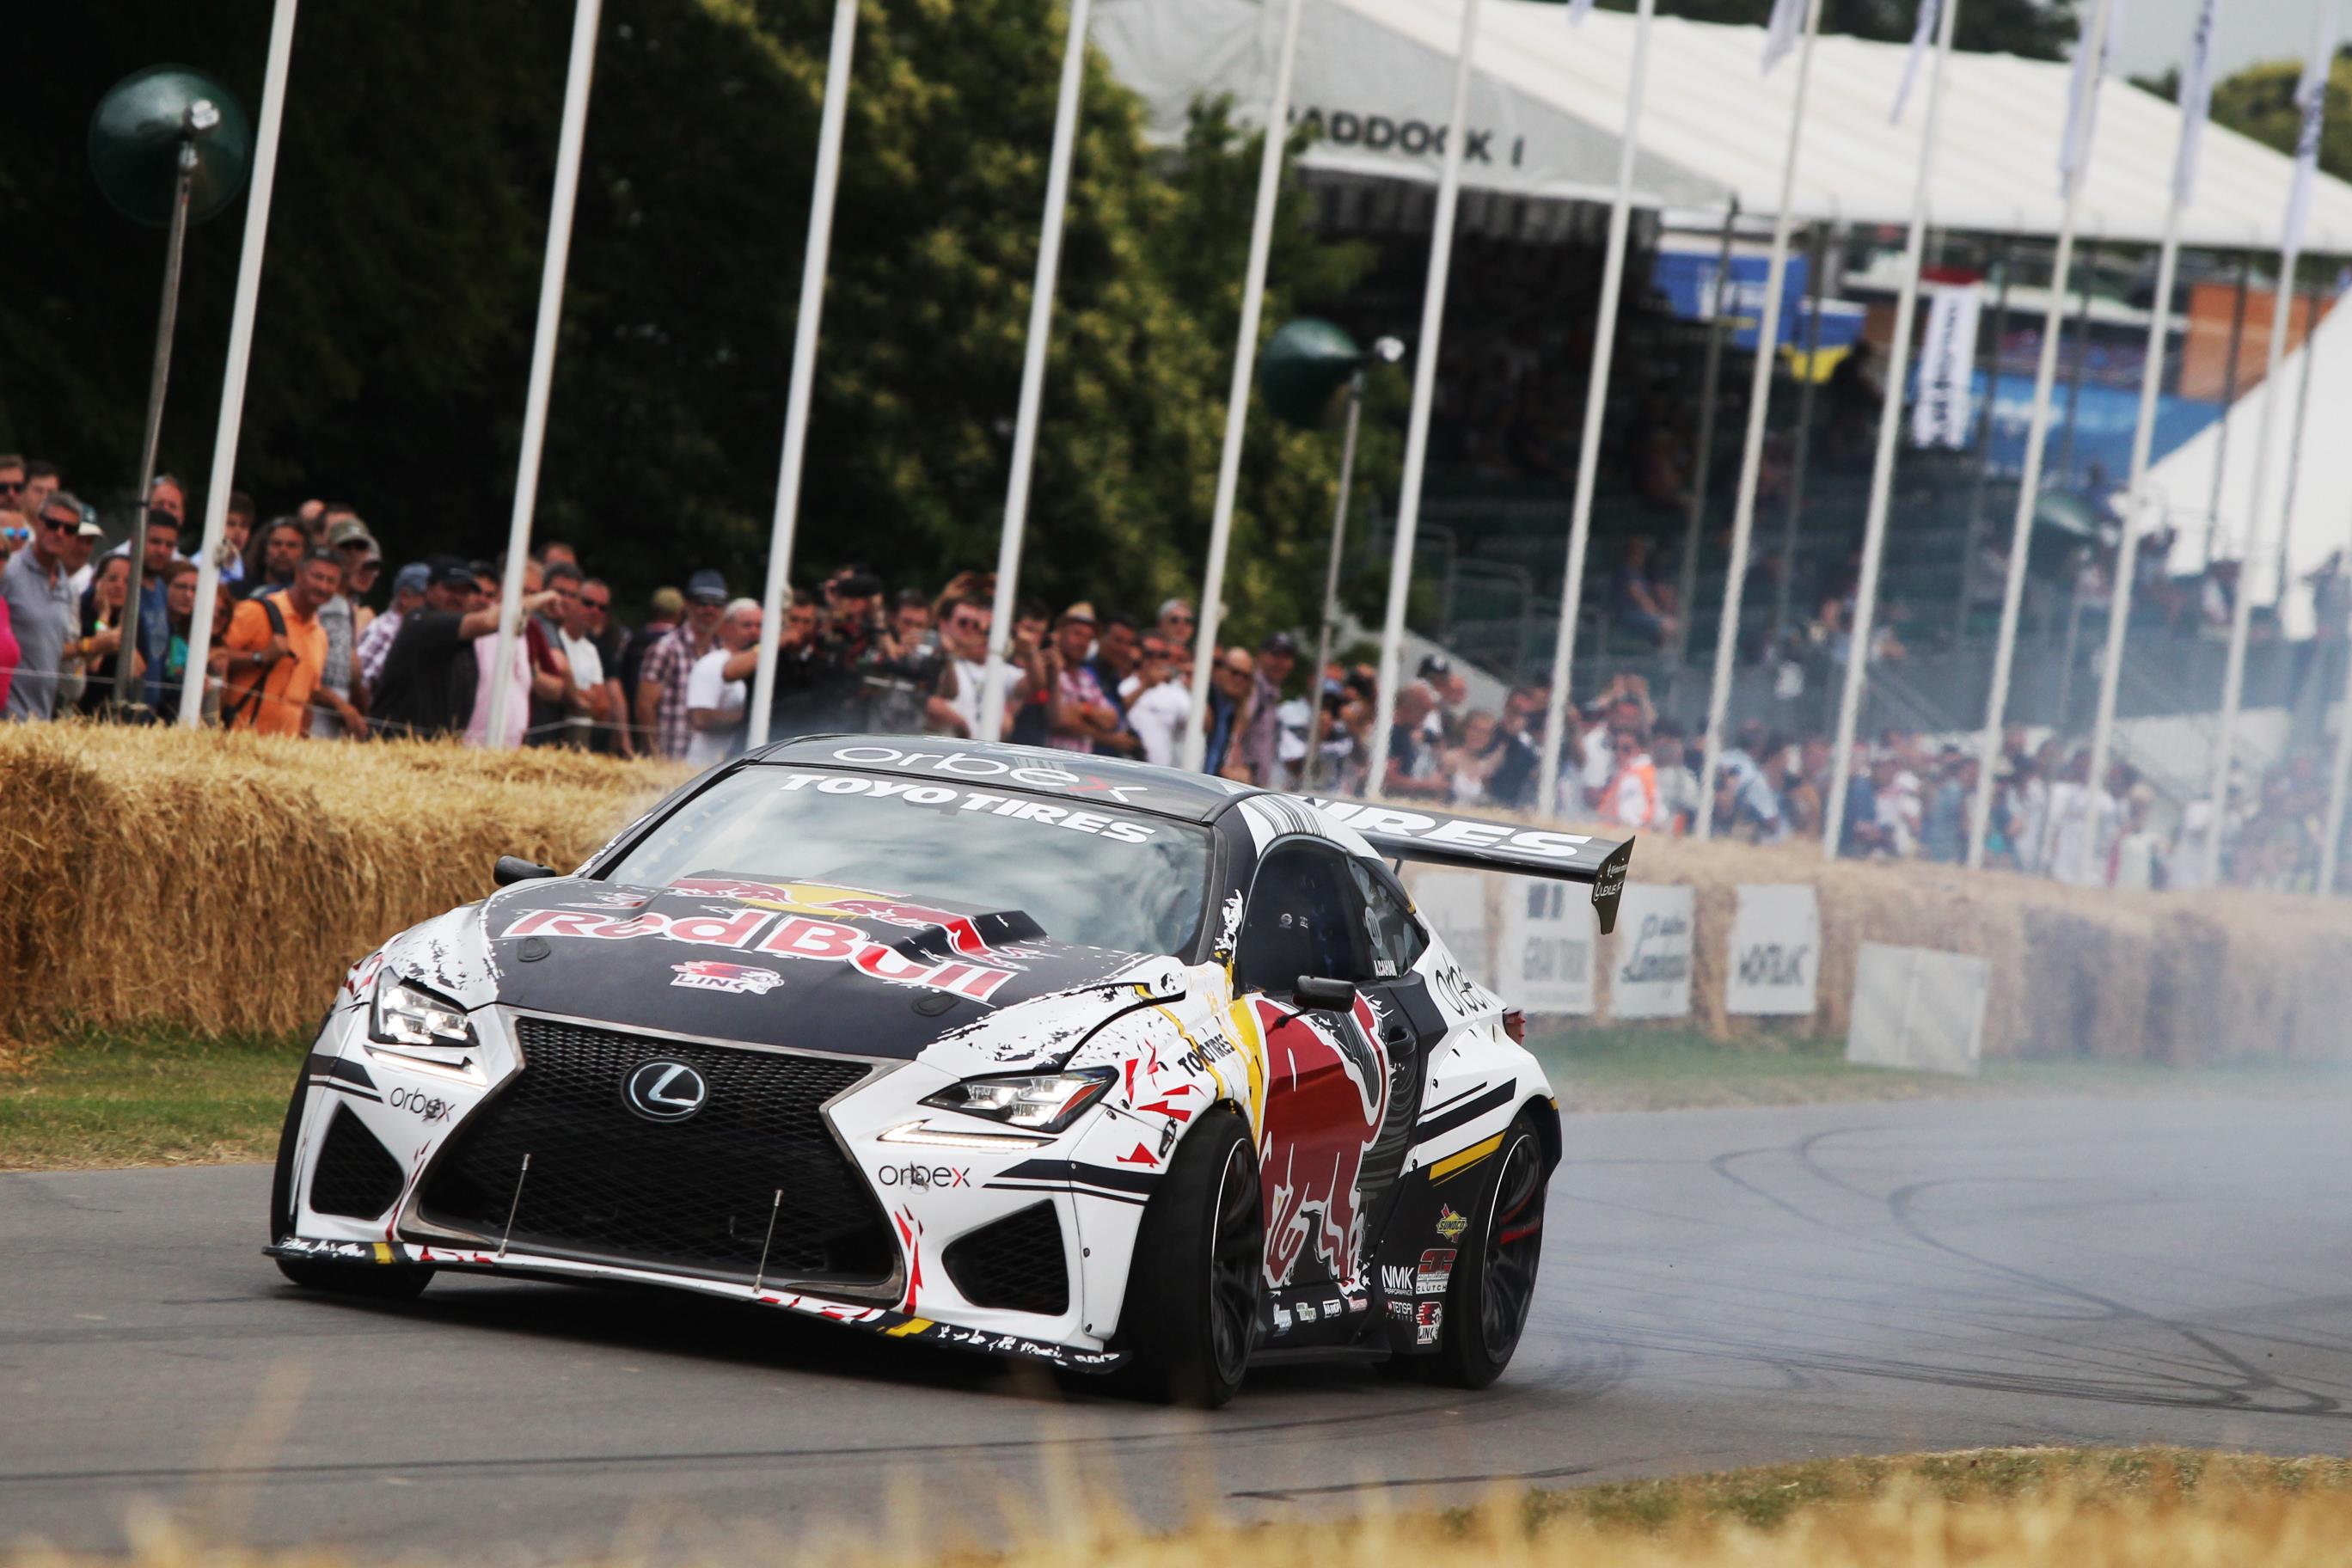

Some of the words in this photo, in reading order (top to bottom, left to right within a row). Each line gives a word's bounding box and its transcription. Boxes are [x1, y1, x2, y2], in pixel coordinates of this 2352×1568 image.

[1287, 105, 1494, 165] ADDOK
[781, 773, 959, 805] TOYO
[959, 791, 1157, 845] TIRES
[501, 908, 778, 952] Red
[753, 915, 1018, 1008] Bull
[1204, 1033, 1235, 1060] TIRES
[389, 1087, 456, 1122] orbex
[878, 1161, 971, 1189] orbex
[1439, 1220, 1467, 1231] SUNOCO
[1381, 1265, 1415, 1289] NMK
